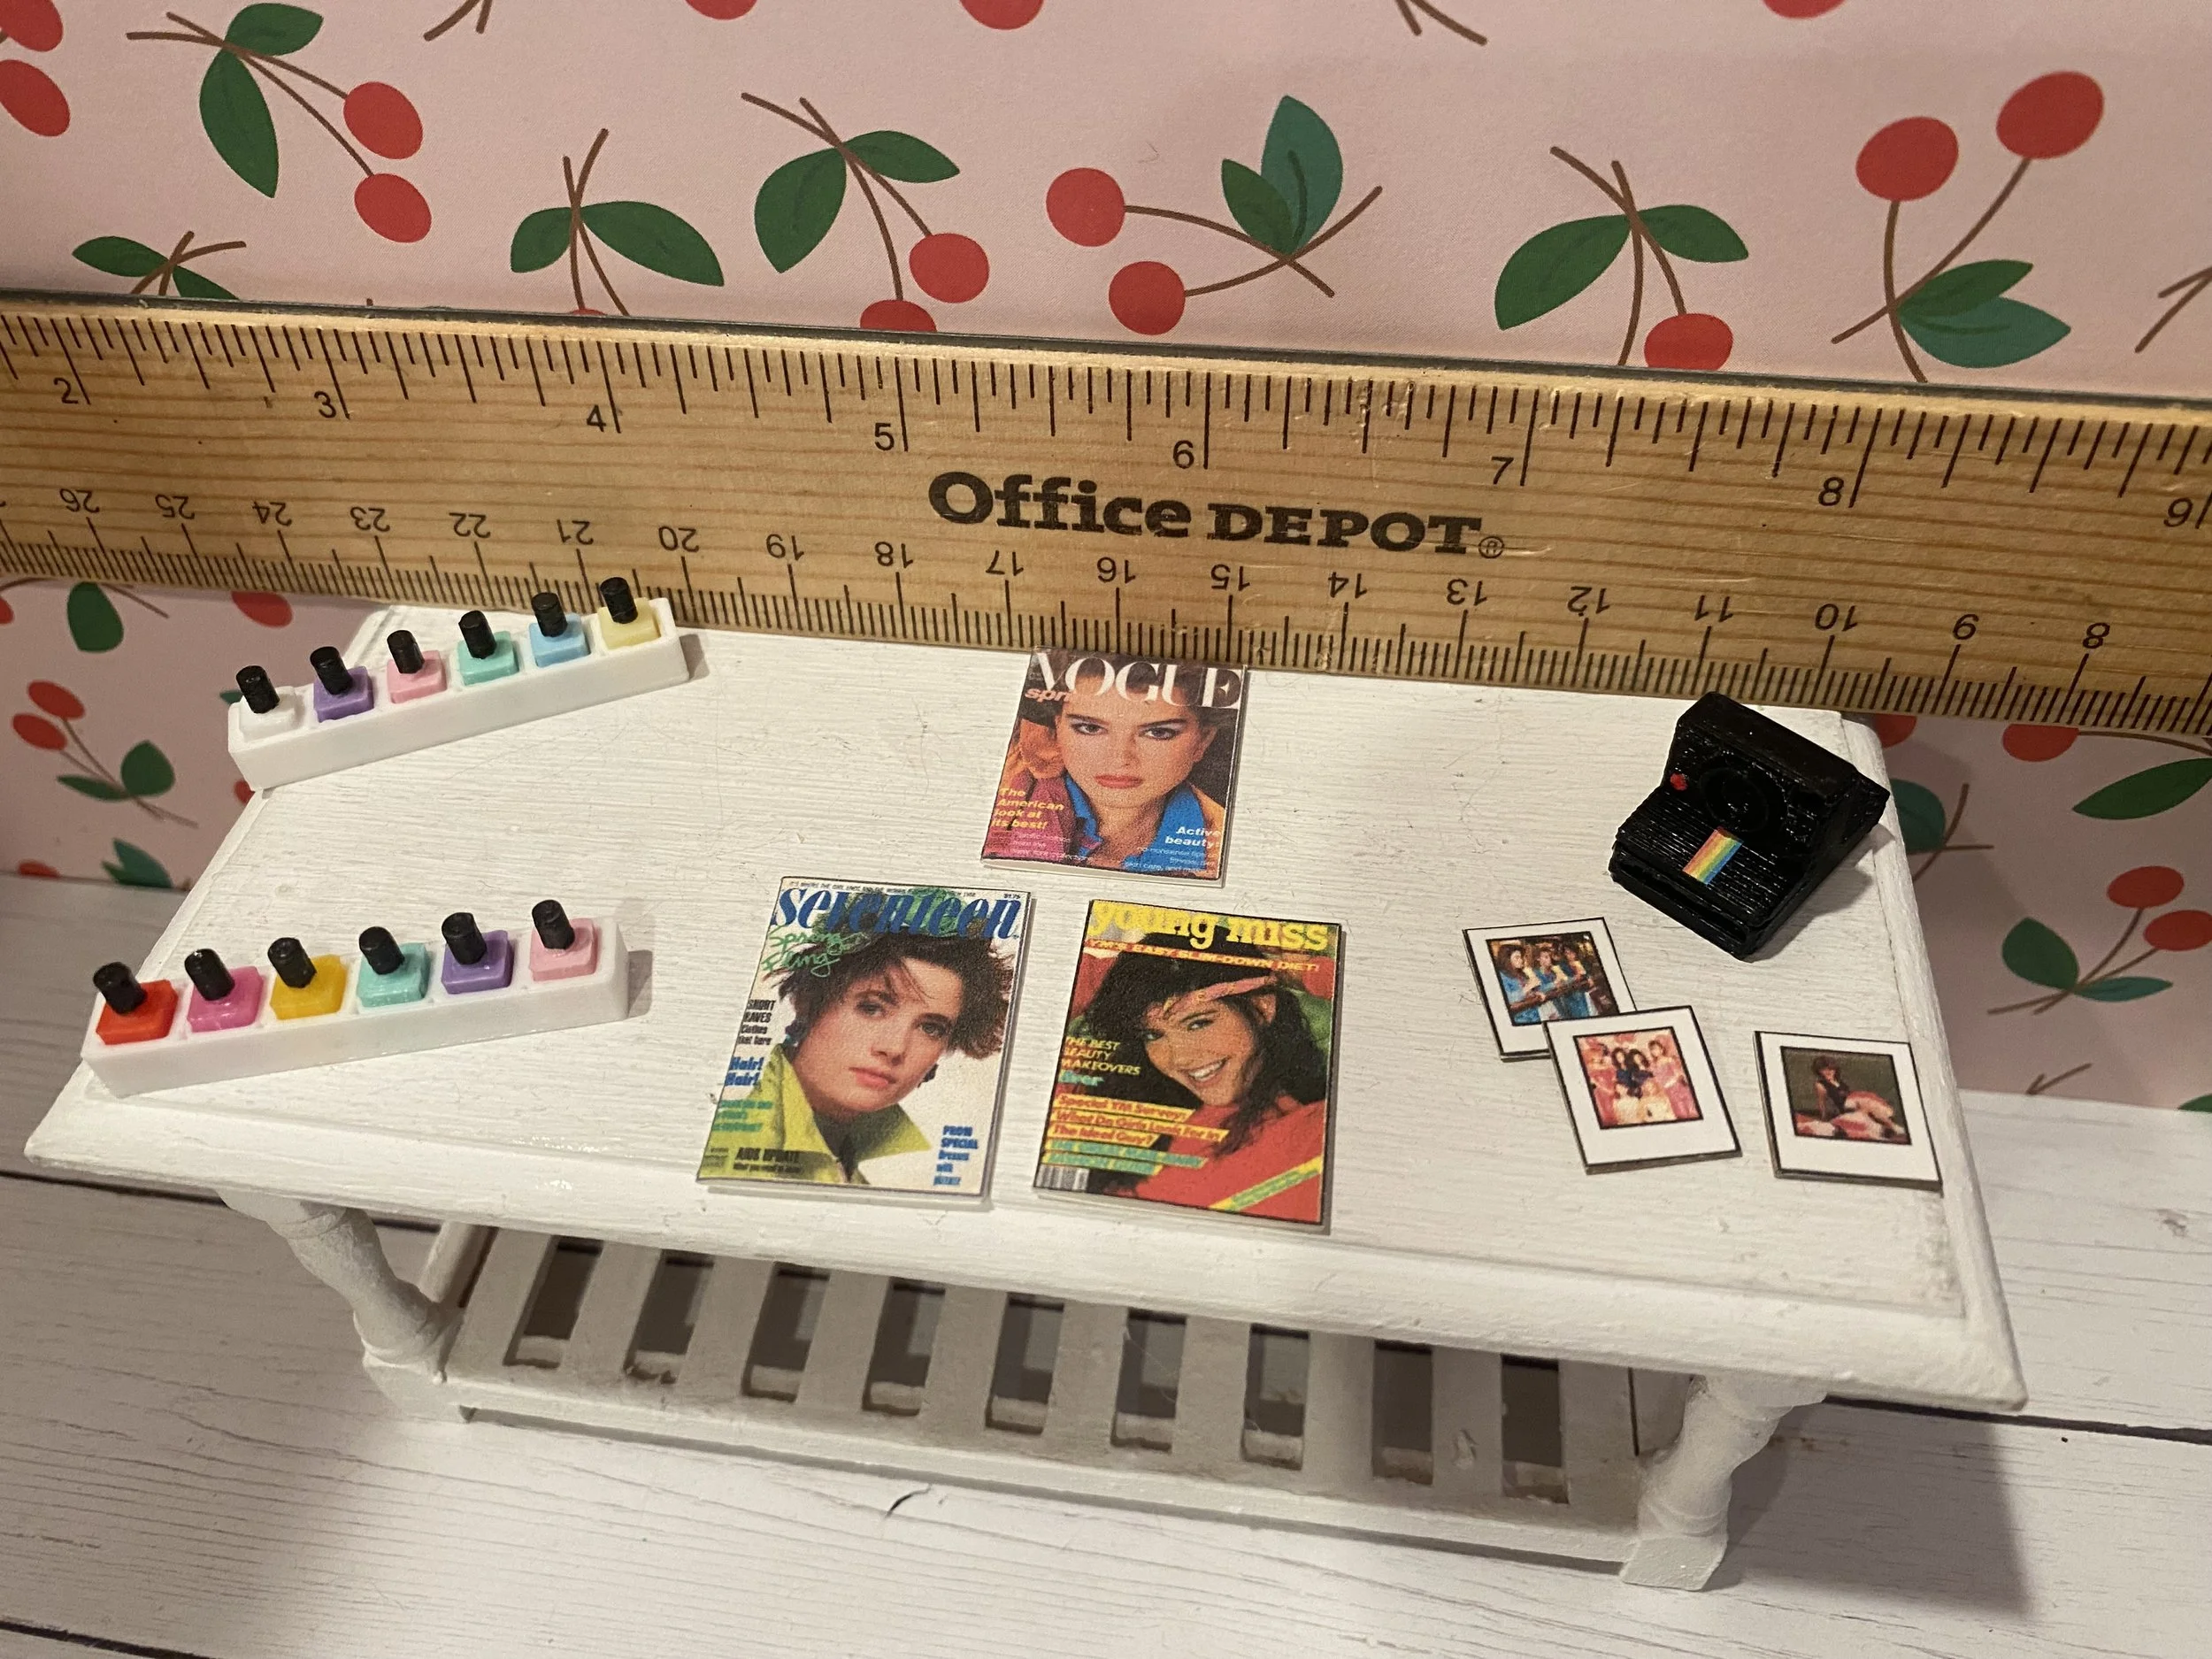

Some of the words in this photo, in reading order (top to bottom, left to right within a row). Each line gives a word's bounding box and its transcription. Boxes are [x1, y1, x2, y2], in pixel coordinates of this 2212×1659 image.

[54, 380, 80, 403] 2
[314, 393, 337, 419] 3
[586, 404, 607, 433] 4
[874, 422, 895, 451] 5
[1173, 440, 1195, 470] 6
[1491, 456, 1515, 485] 7
[59, 488, 101, 513] 26
[1818, 476, 1844, 507] 8
[155, 494, 196, 519] 25
[252, 501, 292, 526] 24
[349, 506, 390, 532] 23
[928, 471, 1191, 540] Office
[2163, 496, 2193, 528] 9
[449, 512, 491, 538] 22
[557, 518, 595, 545] 21
[657, 526, 700, 552] 20
[765, 534, 805, 561] 19
[874, 541, 914, 568] 18
[985, 549, 1025, 577] 17
[1096, 557, 1137, 584] 16
[1210, 565, 1250, 592] 15
[1327, 571, 1368, 599] 14
[1447, 579, 1488, 606] 13
[1567, 586, 1610, 613] 12
[1694, 595, 1734, 623] 11
[1816, 603, 1859, 632] 10
[1952, 613, 1979, 641] 9
[2082, 622, 2111, 649] 8
[1032, 651, 1243, 710] VOGUE
[994, 809, 1025, 818] look
[1027, 810, 1043, 819] at
[997, 798, 1064, 811] American
[1011, 818, 1048, 830] best!
[1175, 826, 1222, 838] Active
[1087, 899, 1219, 949] young
[1225, 917, 1328, 951] miss
[1088, 1039, 1121, 1051] BEST
